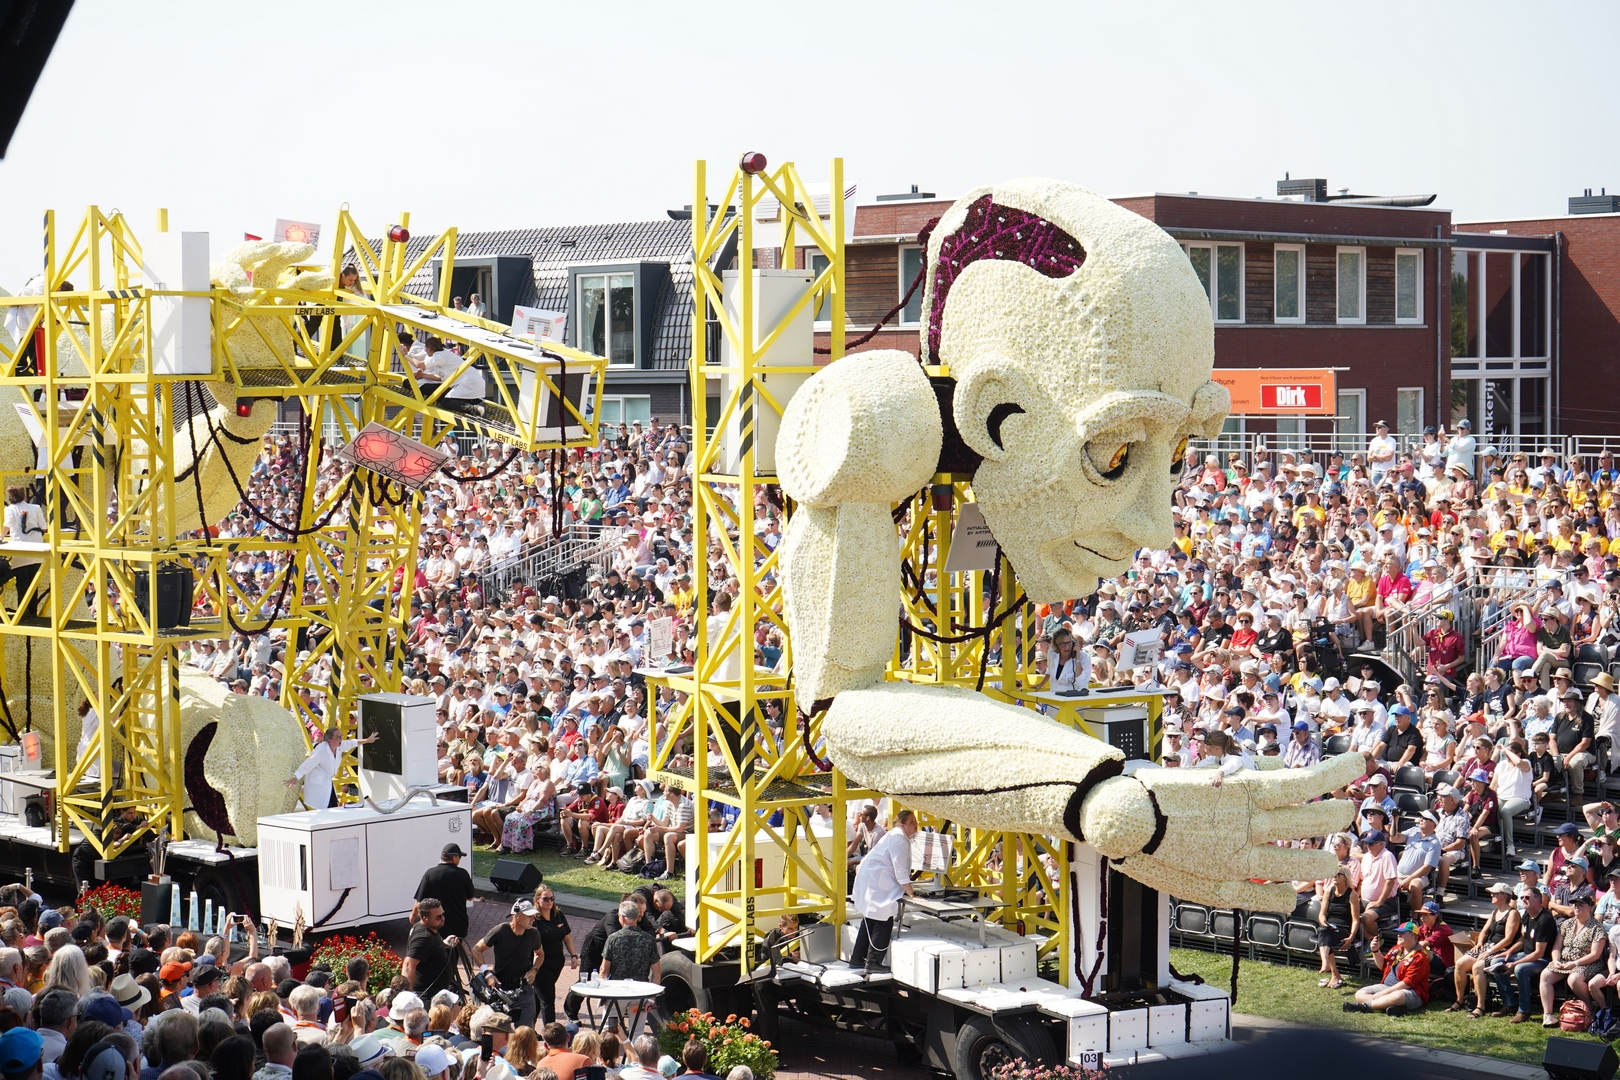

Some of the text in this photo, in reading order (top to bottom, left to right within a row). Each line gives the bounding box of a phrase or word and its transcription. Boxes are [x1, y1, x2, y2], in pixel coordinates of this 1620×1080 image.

[294, 308, 336, 316] LENT LABS
[1276, 386, 1306, 406] Dirk
[494, 432, 527, 450] LENT LABS
[656, 774, 684, 789] LENT LABS
[1084, 1054, 1097, 1063] 03
